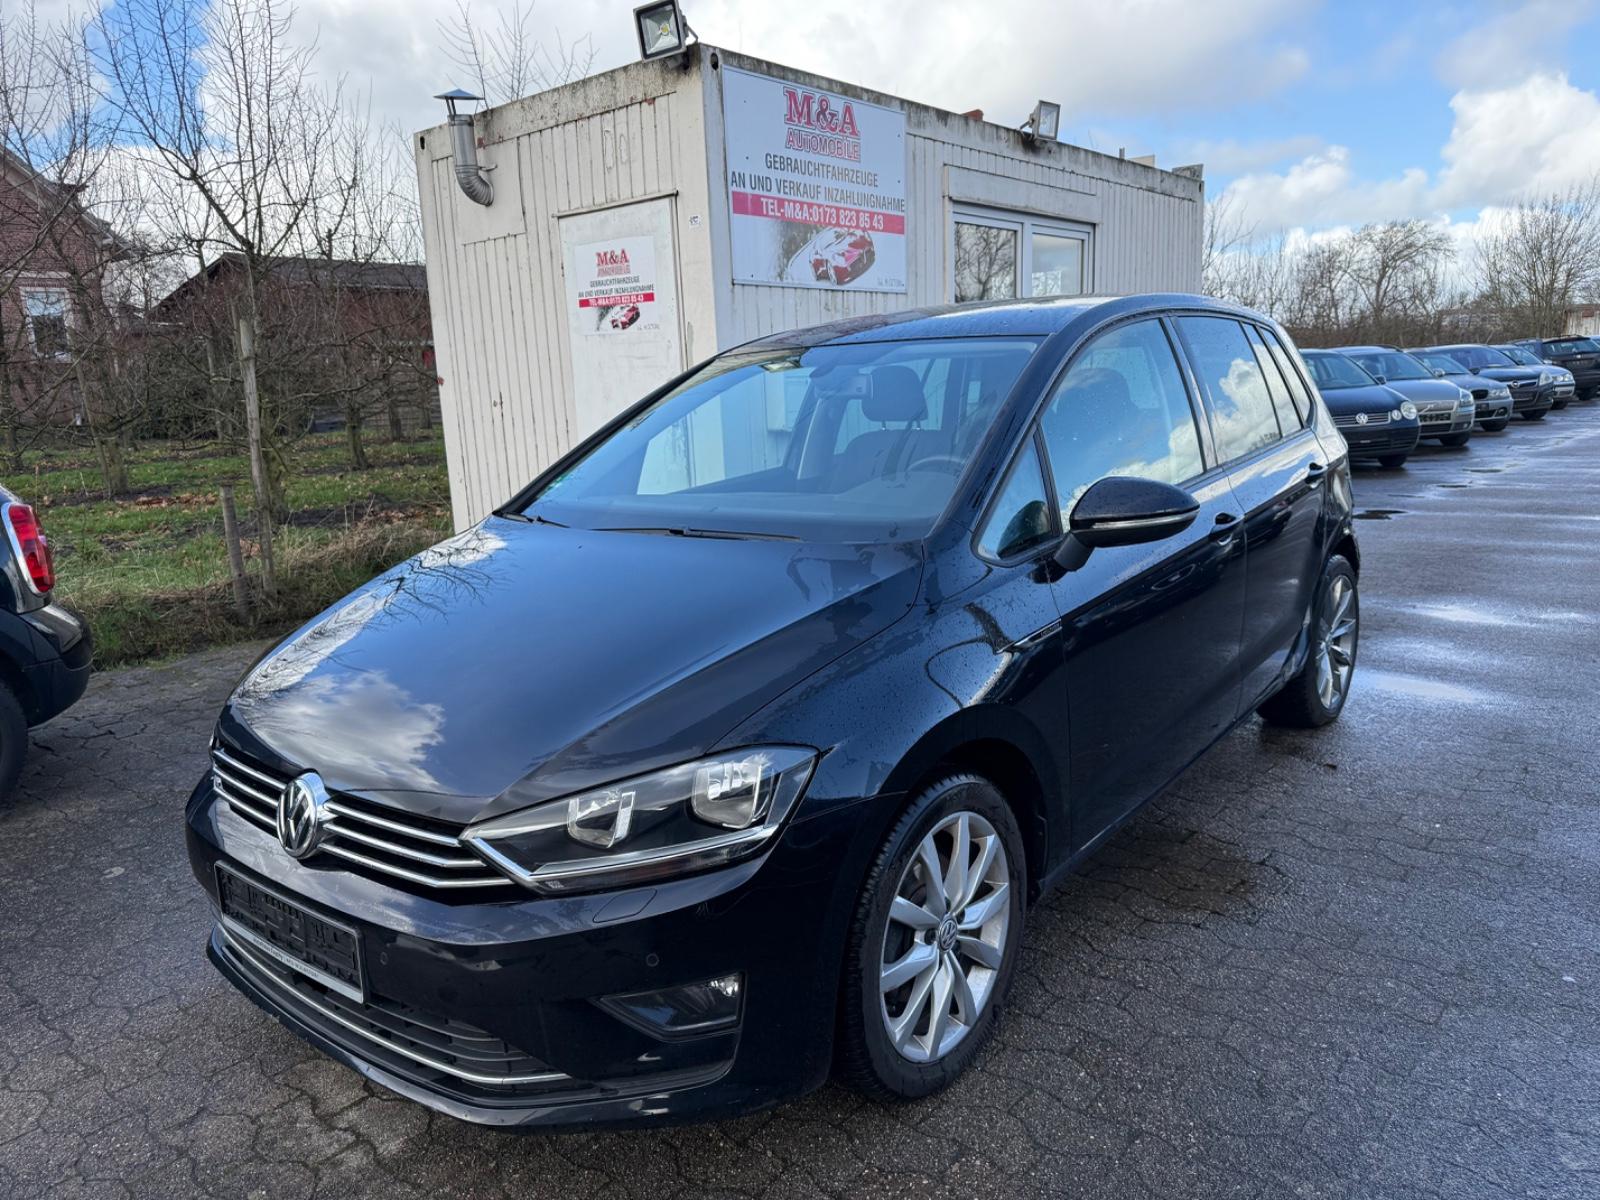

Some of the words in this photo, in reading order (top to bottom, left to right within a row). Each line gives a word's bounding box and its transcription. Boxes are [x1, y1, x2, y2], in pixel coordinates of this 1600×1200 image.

[783, 86, 861, 139] M&A
[785, 128, 862, 163] AUTOMOBILE
[765, 152, 879, 188] GEBRAUCHTFAHRZEUGE
[731, 170, 746, 189] AN
[749, 173, 773, 193] UND
[775, 177, 822, 201] VERKAUF
[824, 186, 905, 213] INZAHLUNGNAHME
[839, 208, 857, 227] 823
[872, 213, 884, 230] 43
[596, 248, 630, 267] M&A
